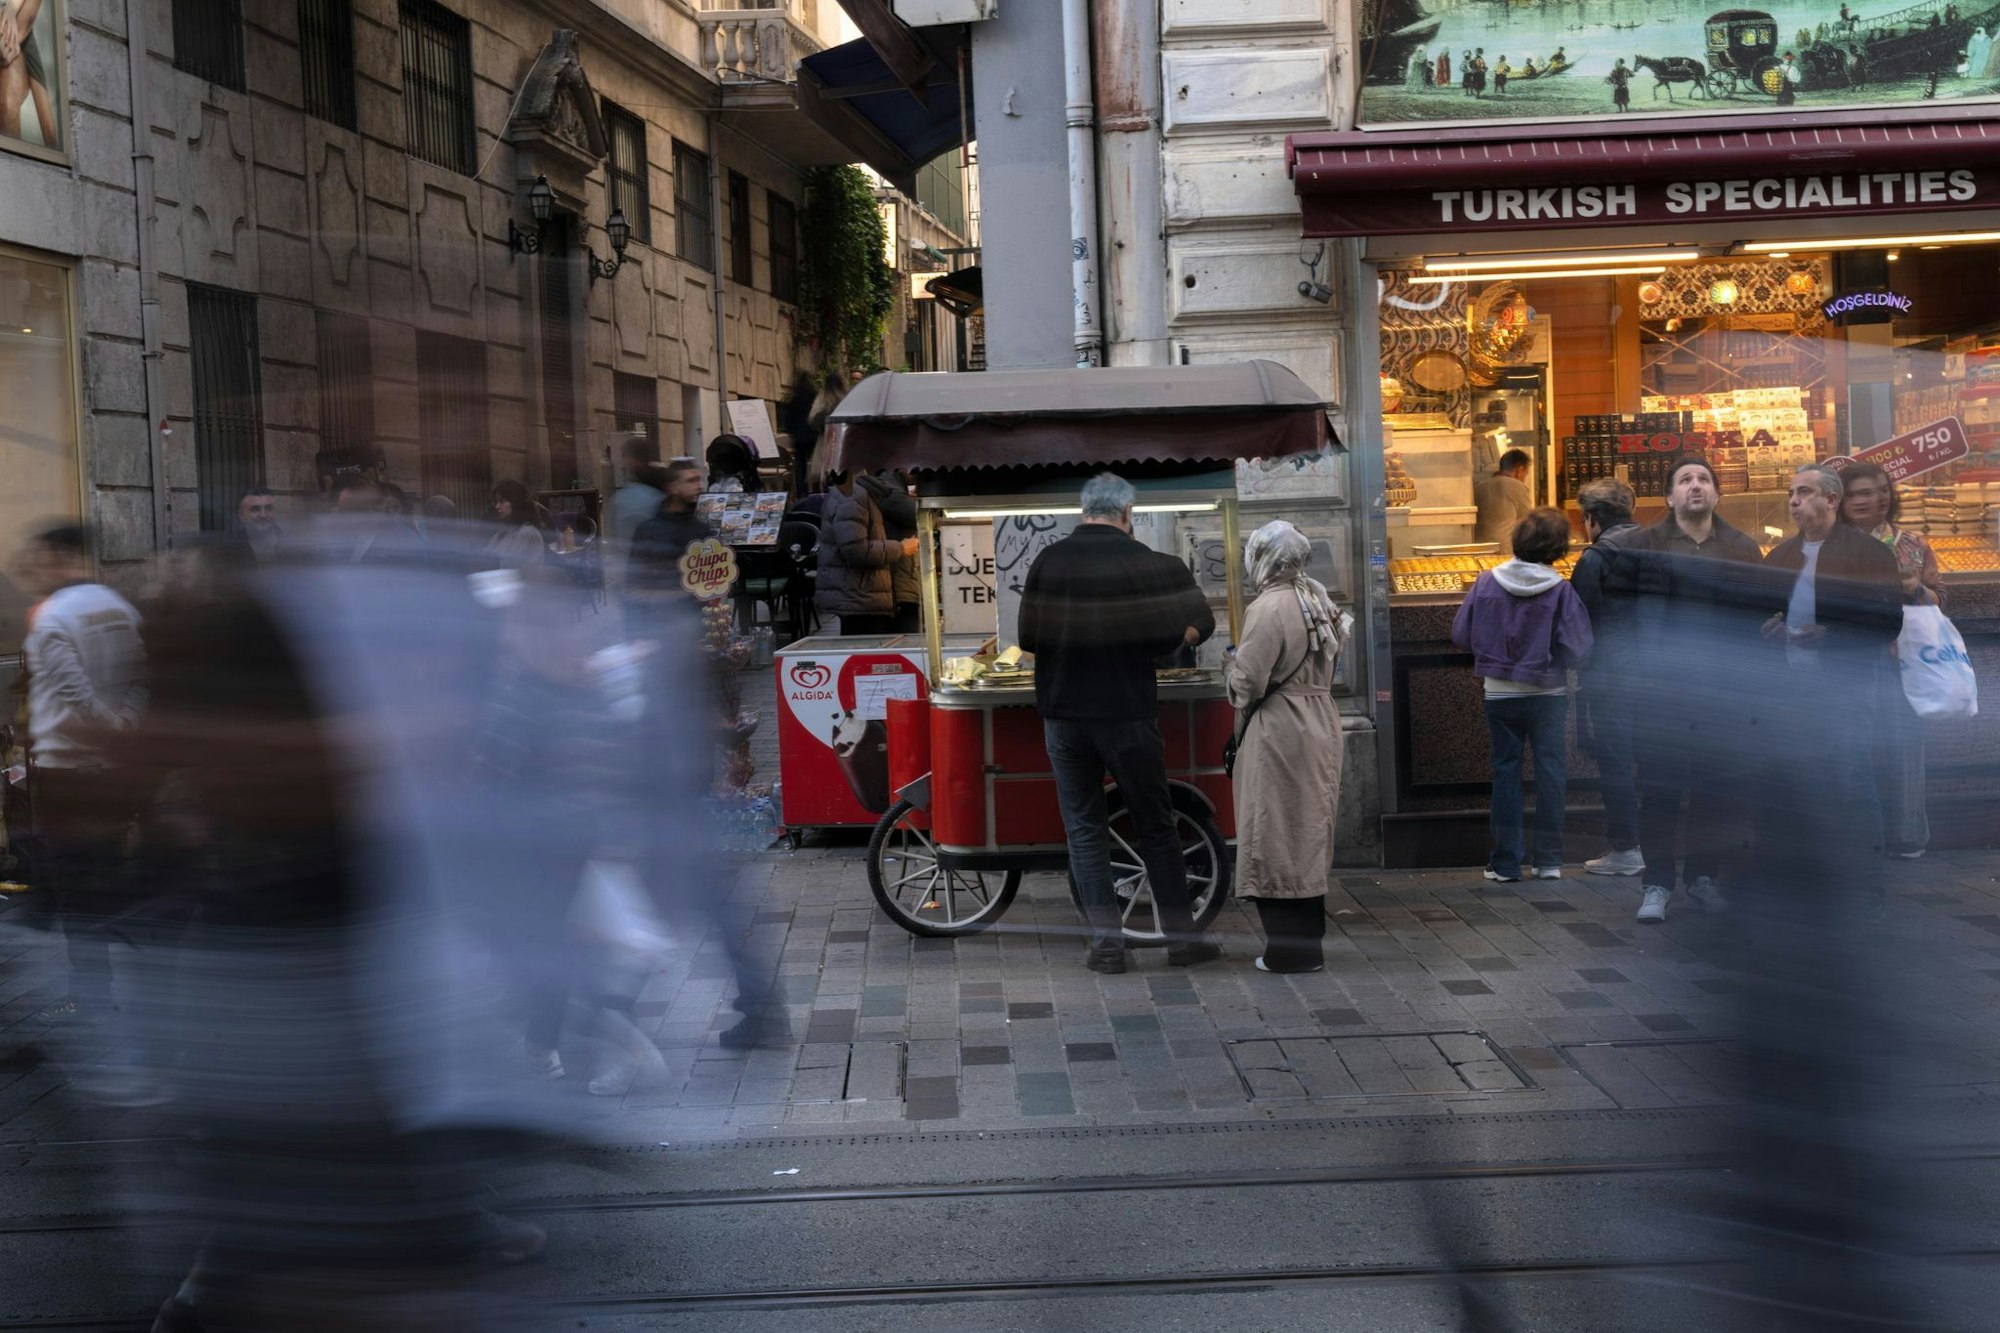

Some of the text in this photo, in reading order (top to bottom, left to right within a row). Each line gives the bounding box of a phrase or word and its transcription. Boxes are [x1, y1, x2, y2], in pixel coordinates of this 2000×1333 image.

[1432, 169, 1977, 223] TURKISH SPECIALITIES
[1825, 291, 1913, 317] HOŞGELDİNİZ
[1617, 429, 1779, 453] KOSKA
[1911, 427, 1951, 453] 750
[1882, 455, 1913, 472] ECIAL
[687, 552, 728, 569] Chupa
[688, 566, 729, 587] Chups
